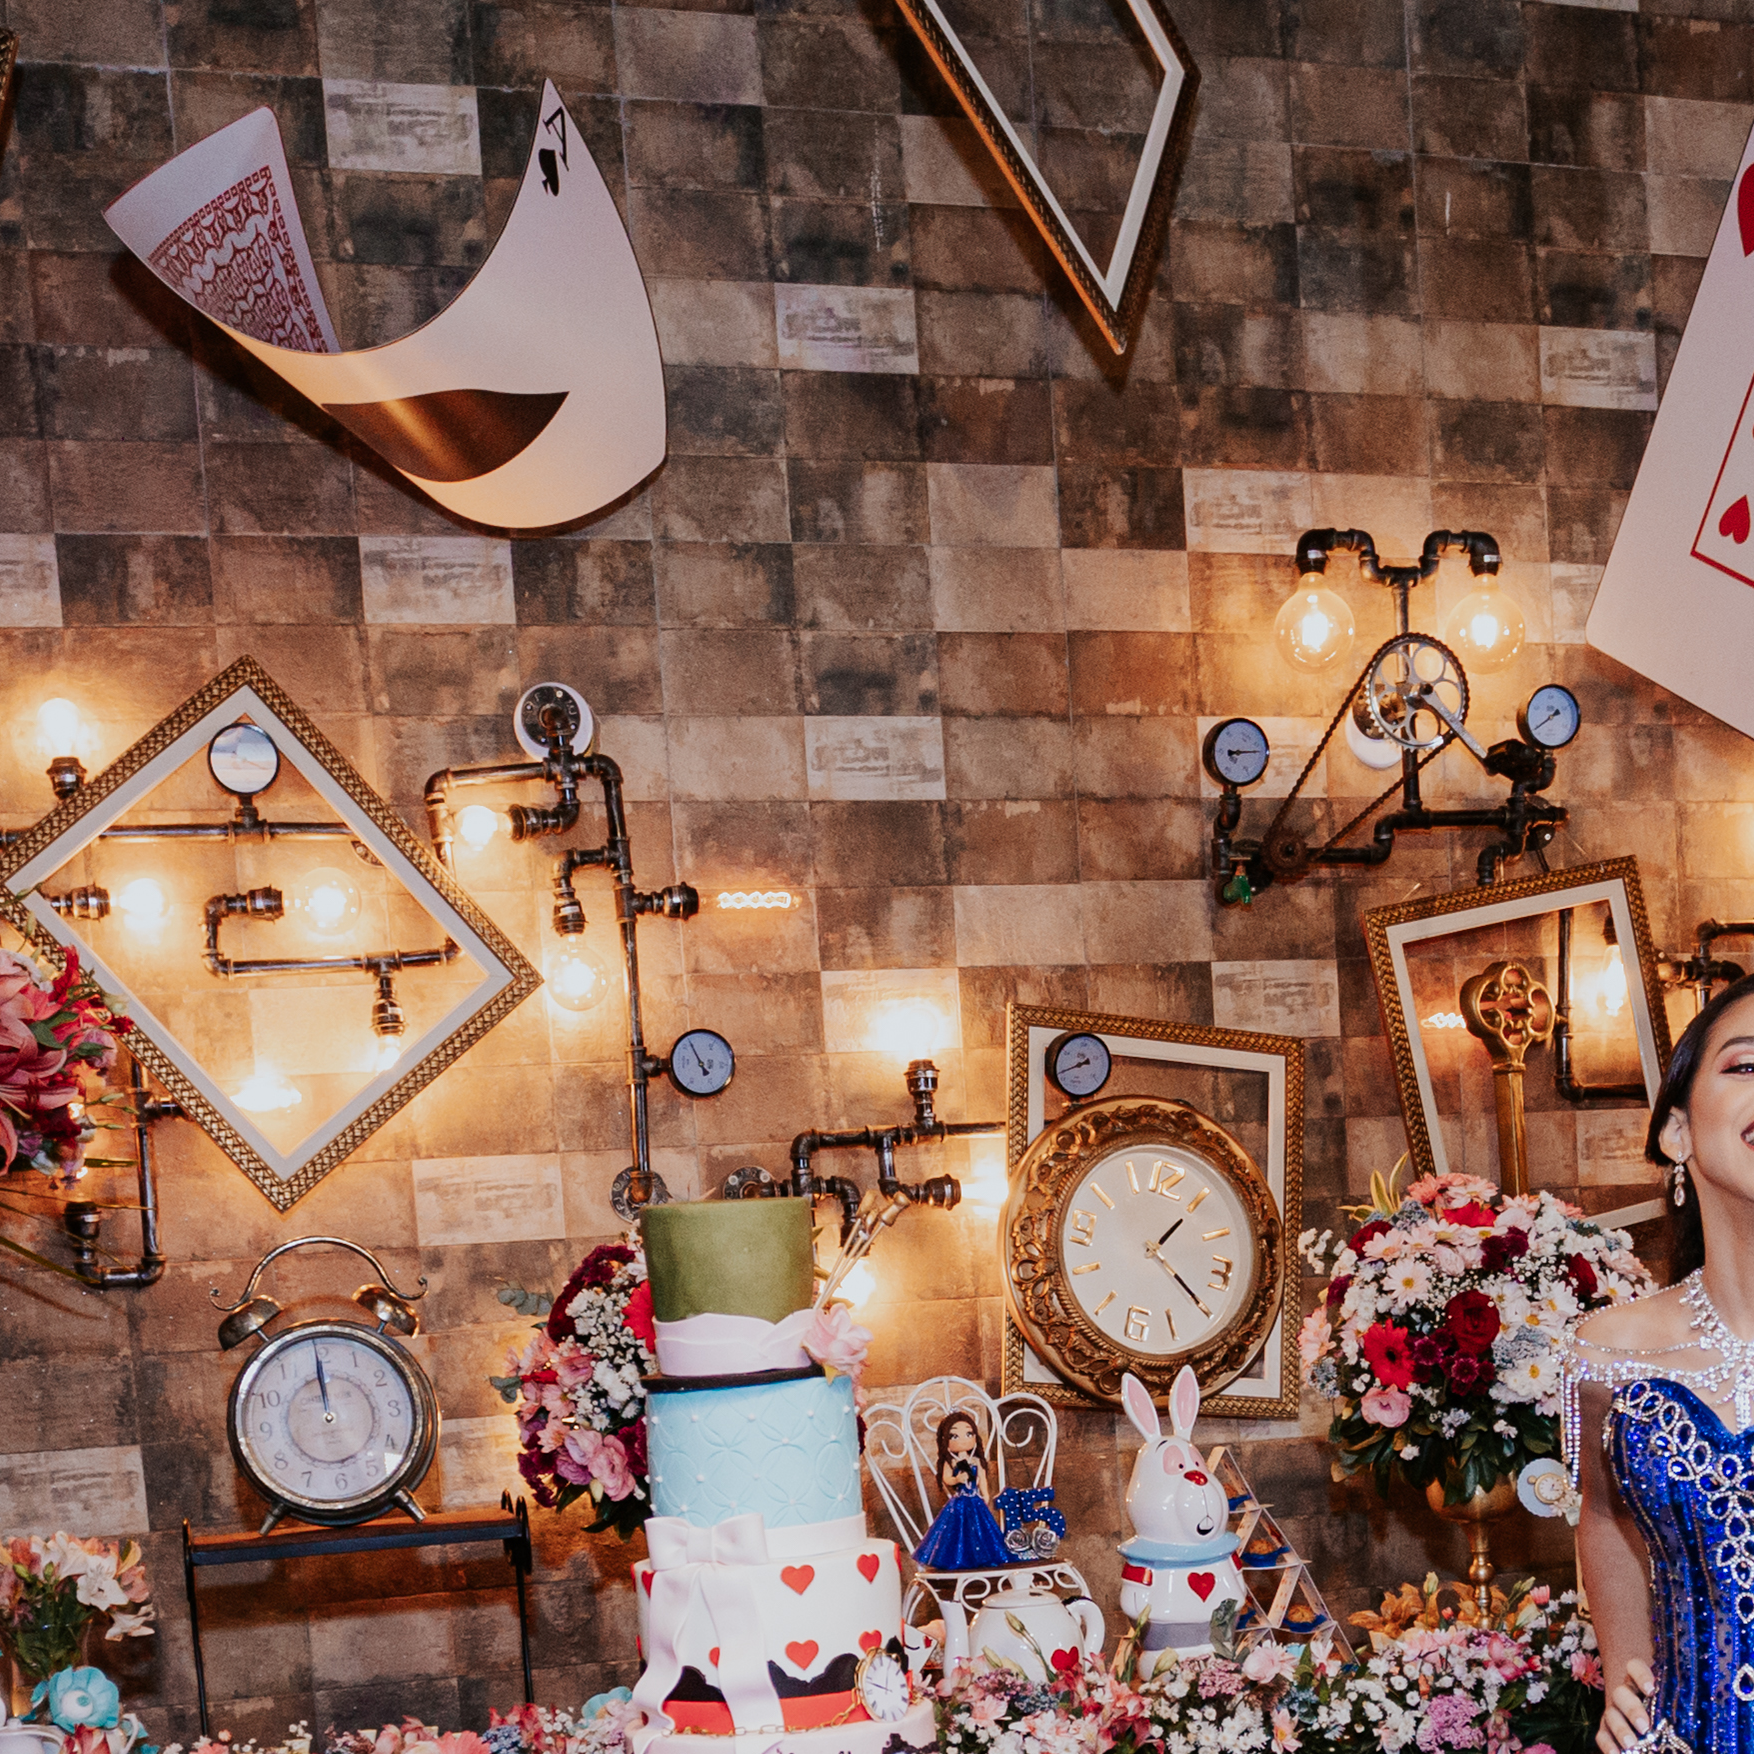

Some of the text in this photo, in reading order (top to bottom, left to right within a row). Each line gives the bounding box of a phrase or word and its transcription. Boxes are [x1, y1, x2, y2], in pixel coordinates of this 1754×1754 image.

[542, 106, 569, 171] A
[1149, 1160, 1186, 1201] 12
[1069, 1209, 1097, 1247] 9
[1208, 1254, 1233, 1292] 3
[1125, 1305, 1152, 1342] 6
[350, 1350, 360, 1368] 1
[373, 1369, 388, 1387] 2
[258, 1390, 281, 1409] 10
[387, 1399, 402, 1417] 3
[259, 1421, 273, 1441] 9
[384, 1434, 397, 1450] 4
[274, 1452, 288, 1470] 8
[365, 1459, 379, 1478] 5
[301, 1470, 313, 1488] 7
[335, 1472, 348, 1490] 6
[995, 1486, 1066, 1540] 15
